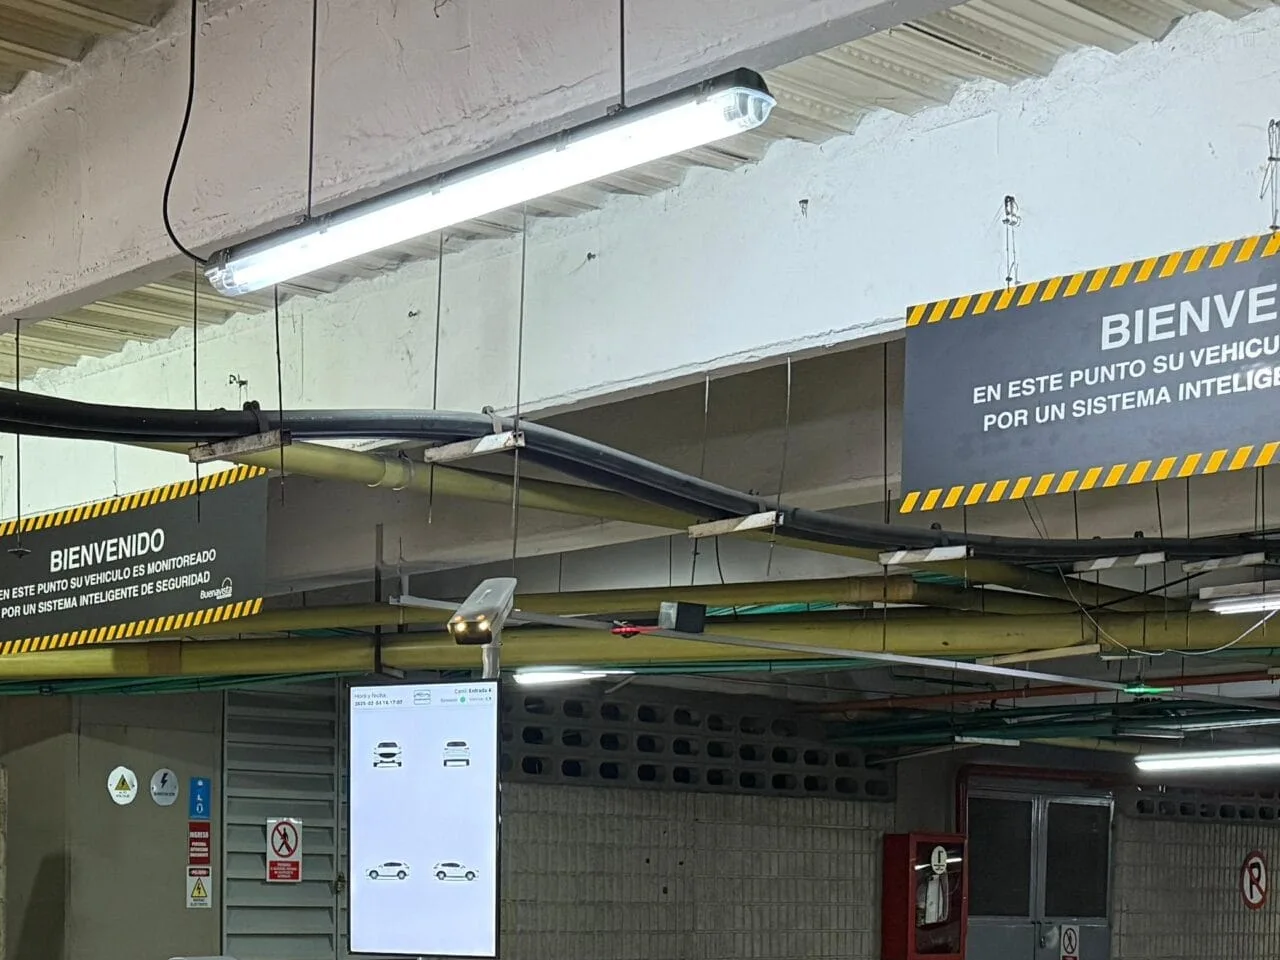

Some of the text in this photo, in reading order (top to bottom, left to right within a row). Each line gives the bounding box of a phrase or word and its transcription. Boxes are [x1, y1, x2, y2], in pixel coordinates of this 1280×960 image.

[1101, 283, 1277, 350] BIENVE
[973, 335, 1280, 404] EN ESTE PUNTO SU VEHICU
[983, 409, 1028, 432] POR
[1035, 403, 1066, 424] UN
[1072, 387, 1171, 417] SISTEMA
[12, 585, 35, 599] ESTE
[37, 579, 68, 595] PUNTO
[70, 576, 83, 589] SU
[84, 567, 130, 588] VEHICULO
[133, 564, 145, 578] ES
[147, 548, 217, 575] MONITOREADO
[50, 528, 164, 572] BIENVENIDO
[1, 571, 210, 619] POR UN SISTEMA INTELIGENTE DE SEGURIDAD
